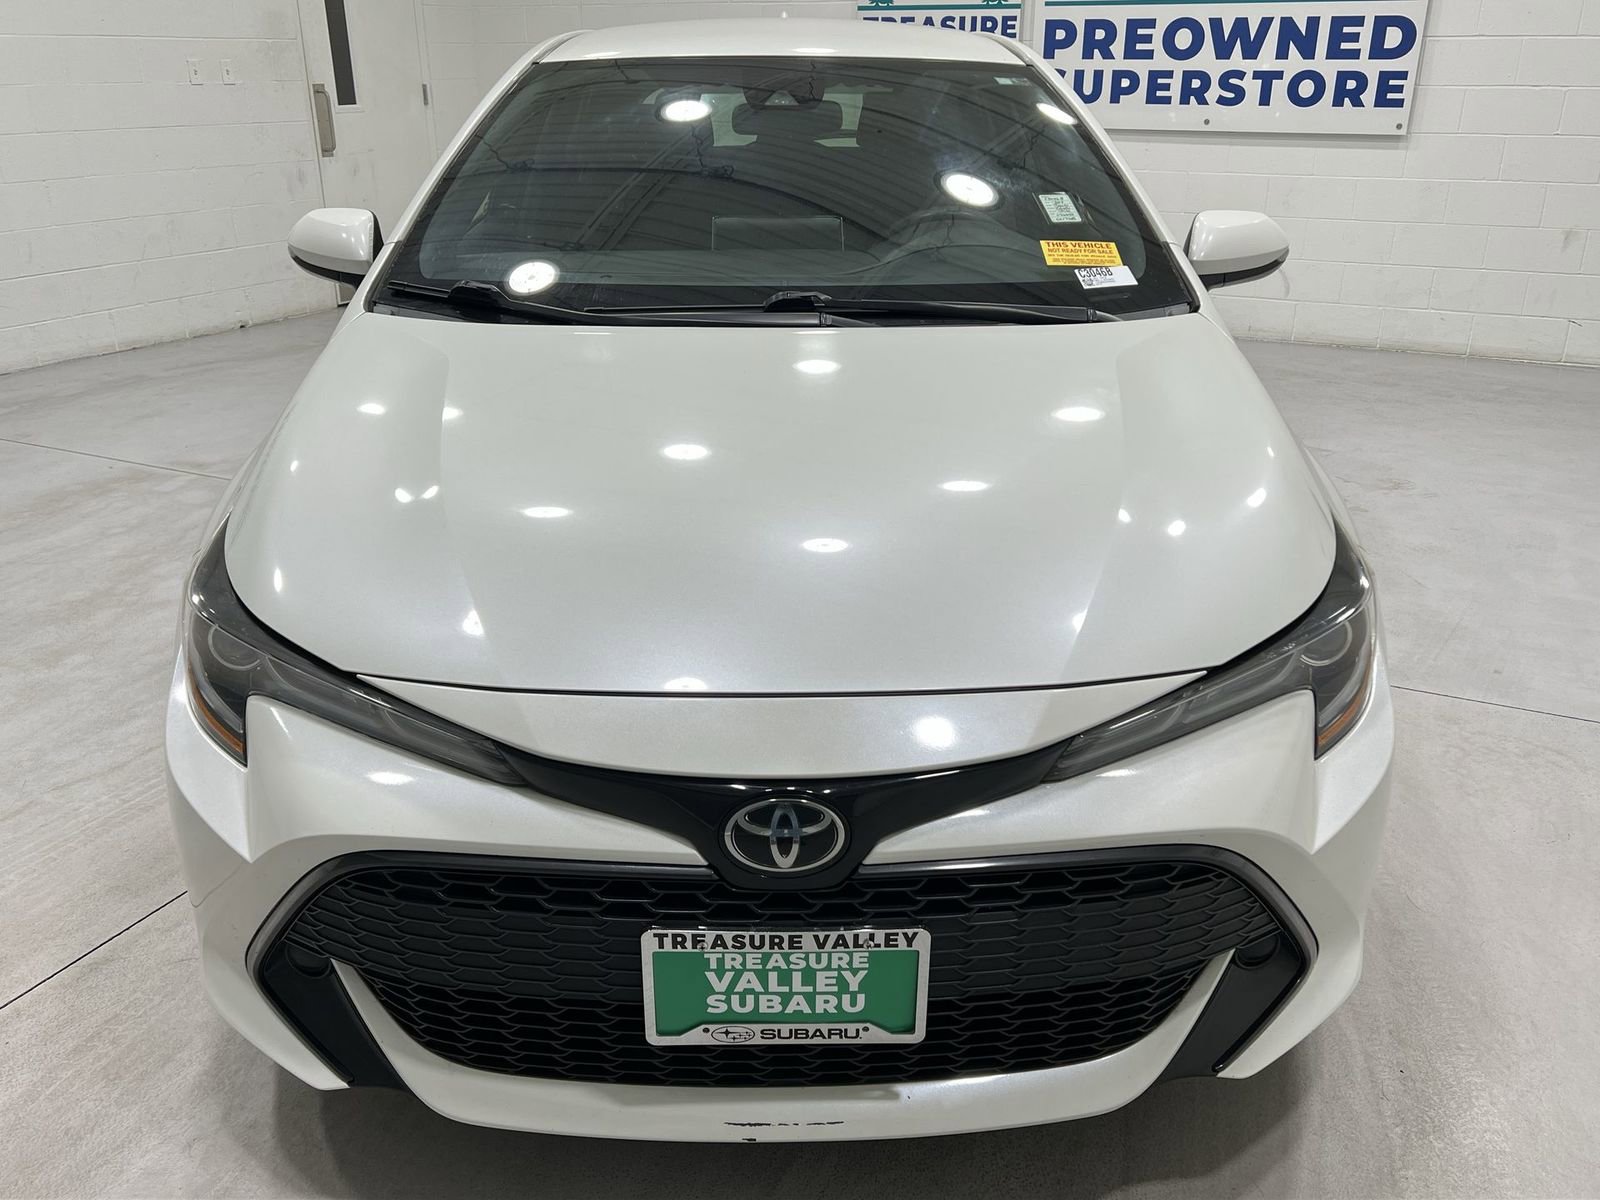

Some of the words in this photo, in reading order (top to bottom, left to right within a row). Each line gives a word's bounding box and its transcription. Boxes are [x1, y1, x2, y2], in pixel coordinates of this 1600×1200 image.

[1043, 15, 1417, 61] PREOWNED
[1053, 68, 1409, 109] UPERSTORE
[1070, 242, 1112, 250] VEHICLE
[653, 932, 803, 950] TREASURE
[812, 931, 919, 949] VALLEY
[703, 951, 870, 970] TREASURE
[704, 970, 868, 993] VALLEY
[705, 993, 866, 1014] SUBARU
